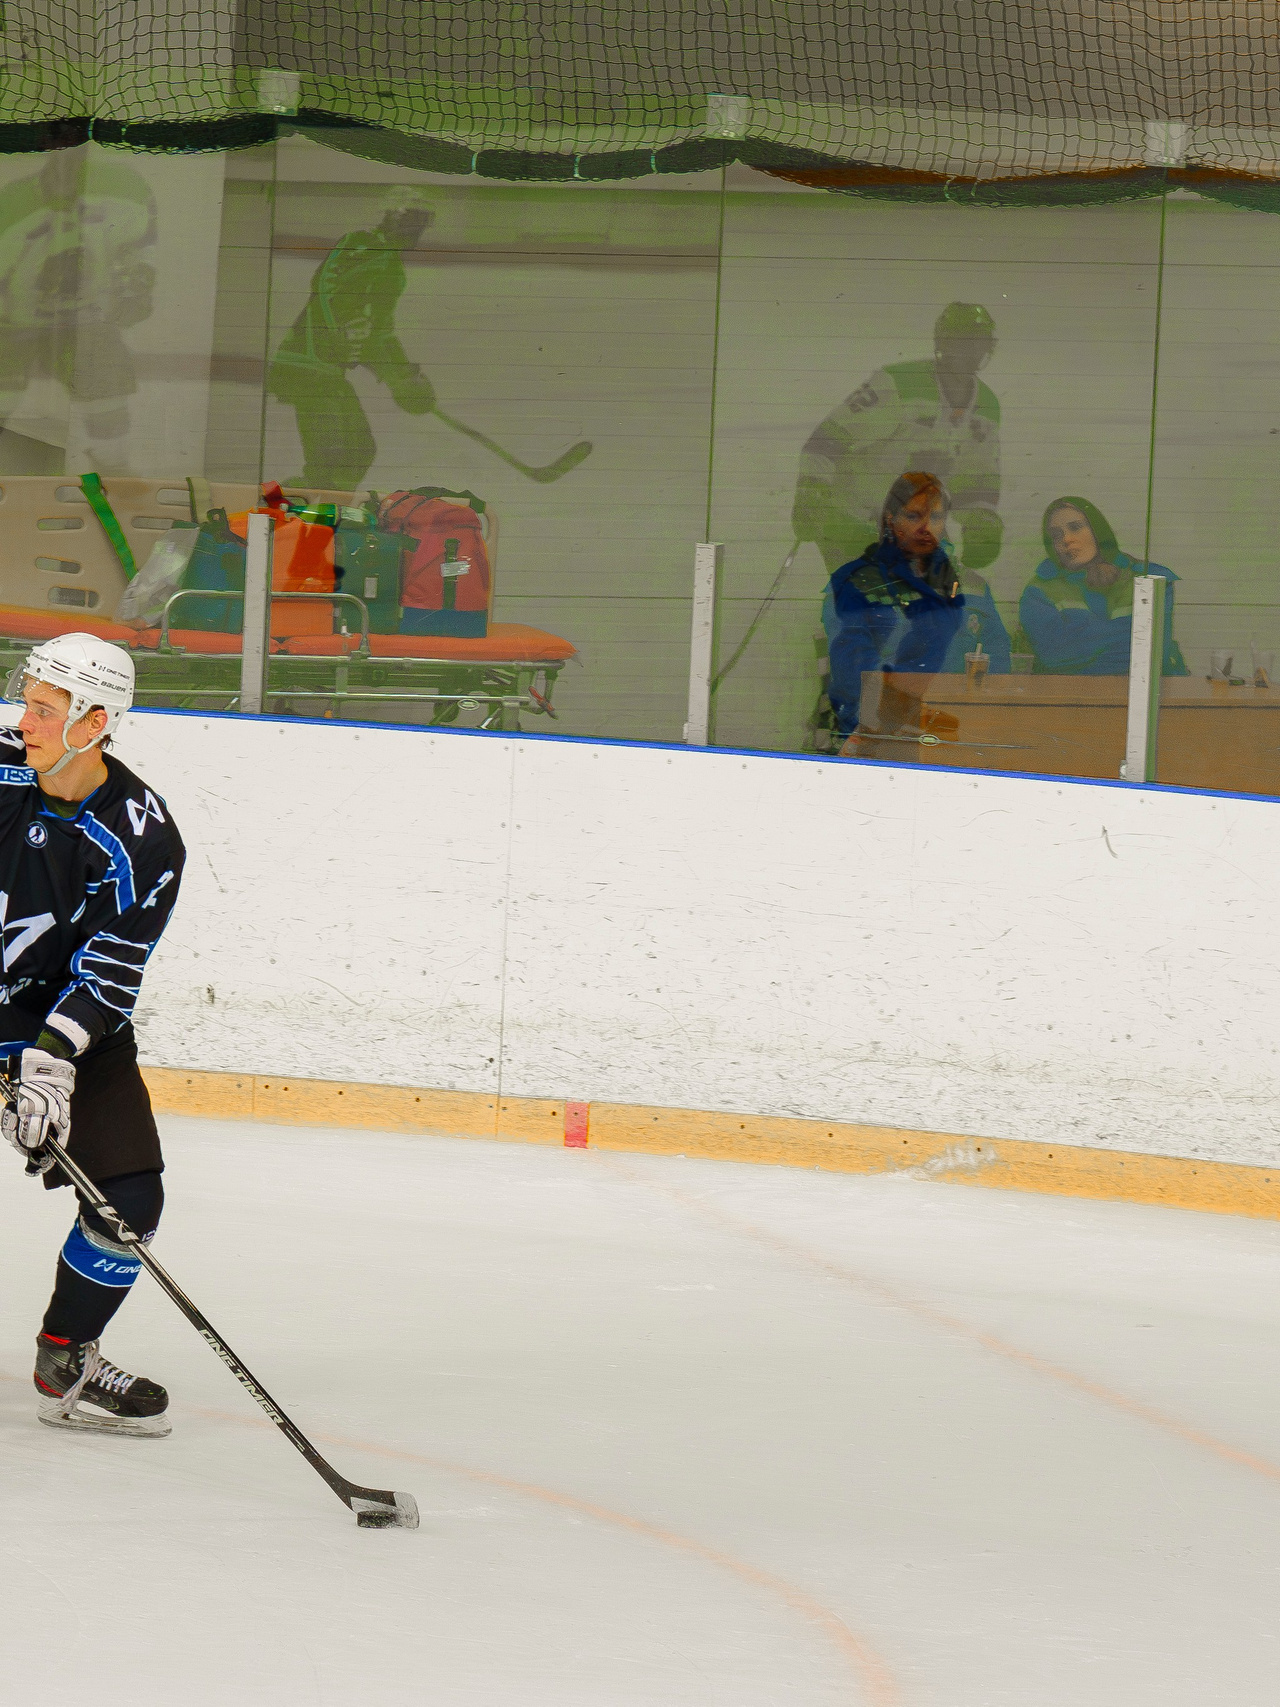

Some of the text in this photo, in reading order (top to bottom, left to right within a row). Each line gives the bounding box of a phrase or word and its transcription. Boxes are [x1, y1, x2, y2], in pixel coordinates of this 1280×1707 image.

[100, 680, 126, 692] BAUER
[199, 1328, 284, 1425] ONE TIMER
